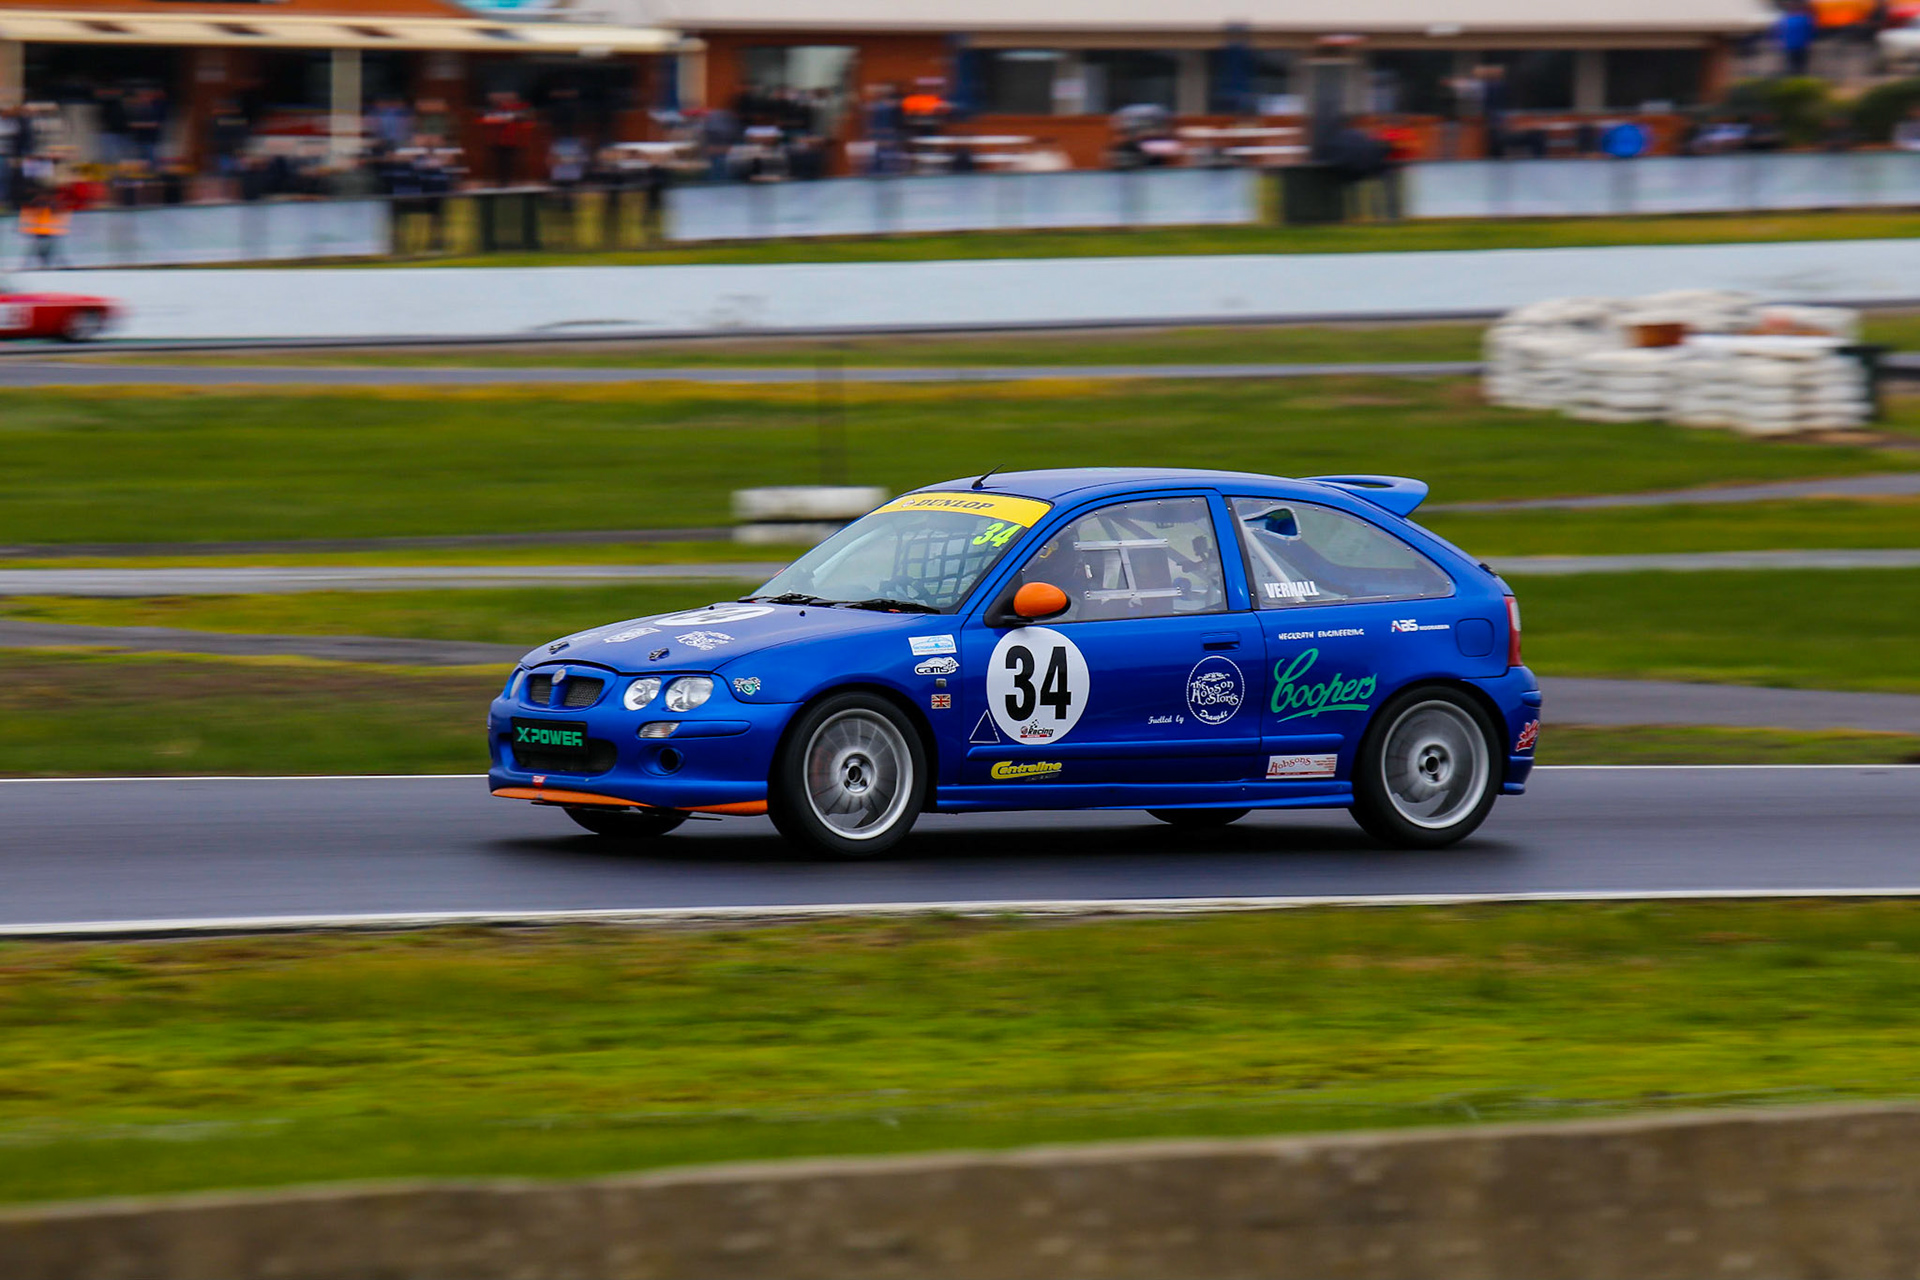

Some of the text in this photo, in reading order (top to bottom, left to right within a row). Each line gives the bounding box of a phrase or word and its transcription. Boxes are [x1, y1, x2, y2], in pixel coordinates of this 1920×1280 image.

[914, 499, 995, 510] DUNLOP
[972, 522, 1023, 548] 34
[1264, 580, 1320, 598] VERNALL
[1004, 645, 1072, 722] 34
[1270, 647, 1378, 719] Coopers
[1269, 756, 1312, 774] Hobsons
